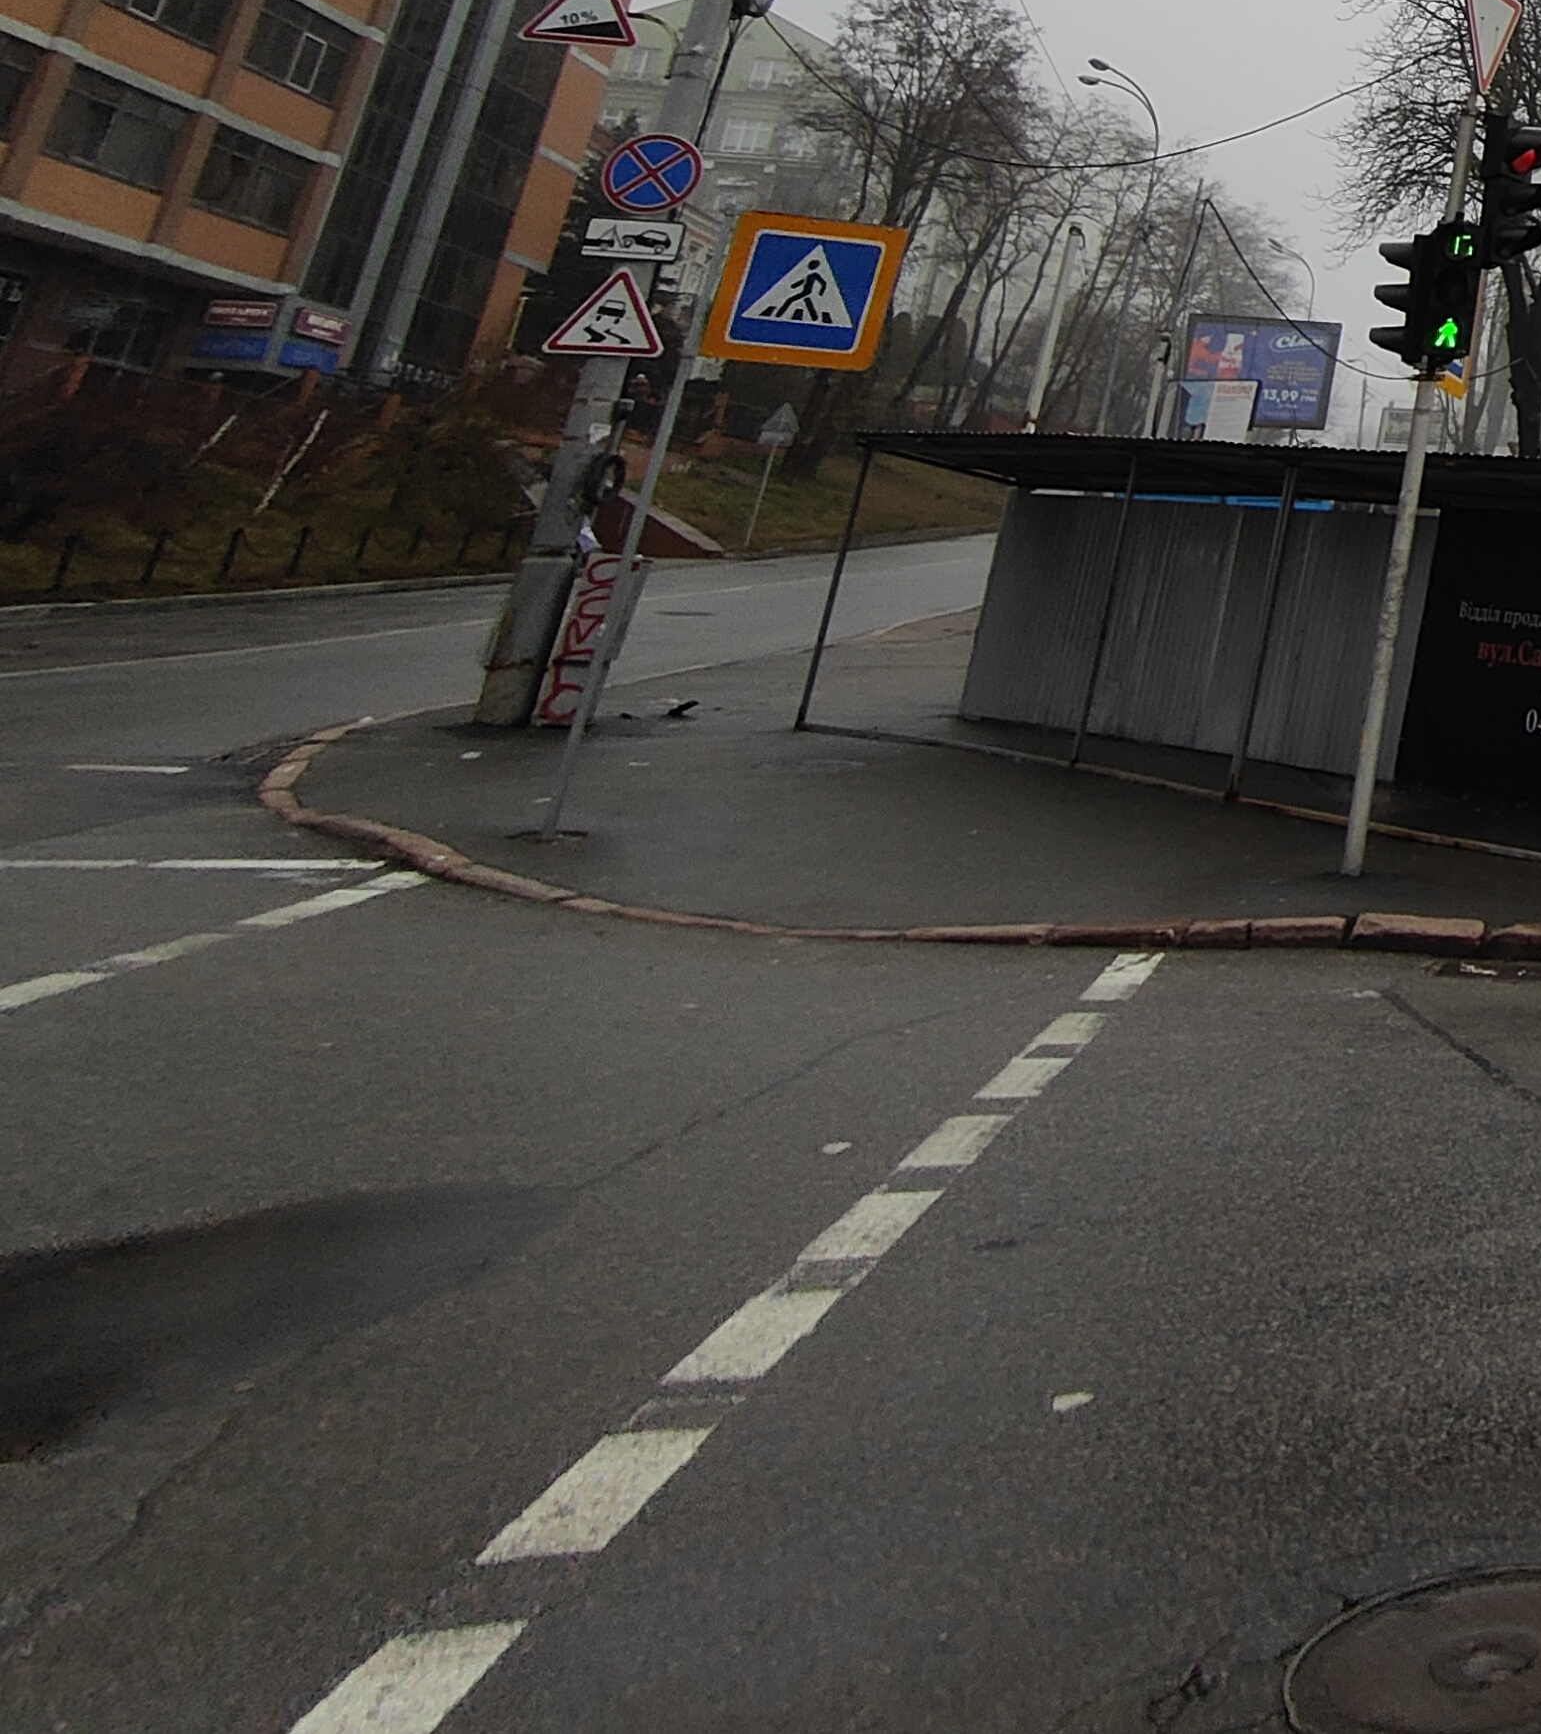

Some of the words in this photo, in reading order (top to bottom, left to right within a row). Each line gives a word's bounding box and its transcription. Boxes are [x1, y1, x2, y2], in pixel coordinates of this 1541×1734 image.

[559, 10, 598, 25] 10%
[1263, 388, 1299, 403] 13,99
[1458, 600, 1501, 623] Відділ
